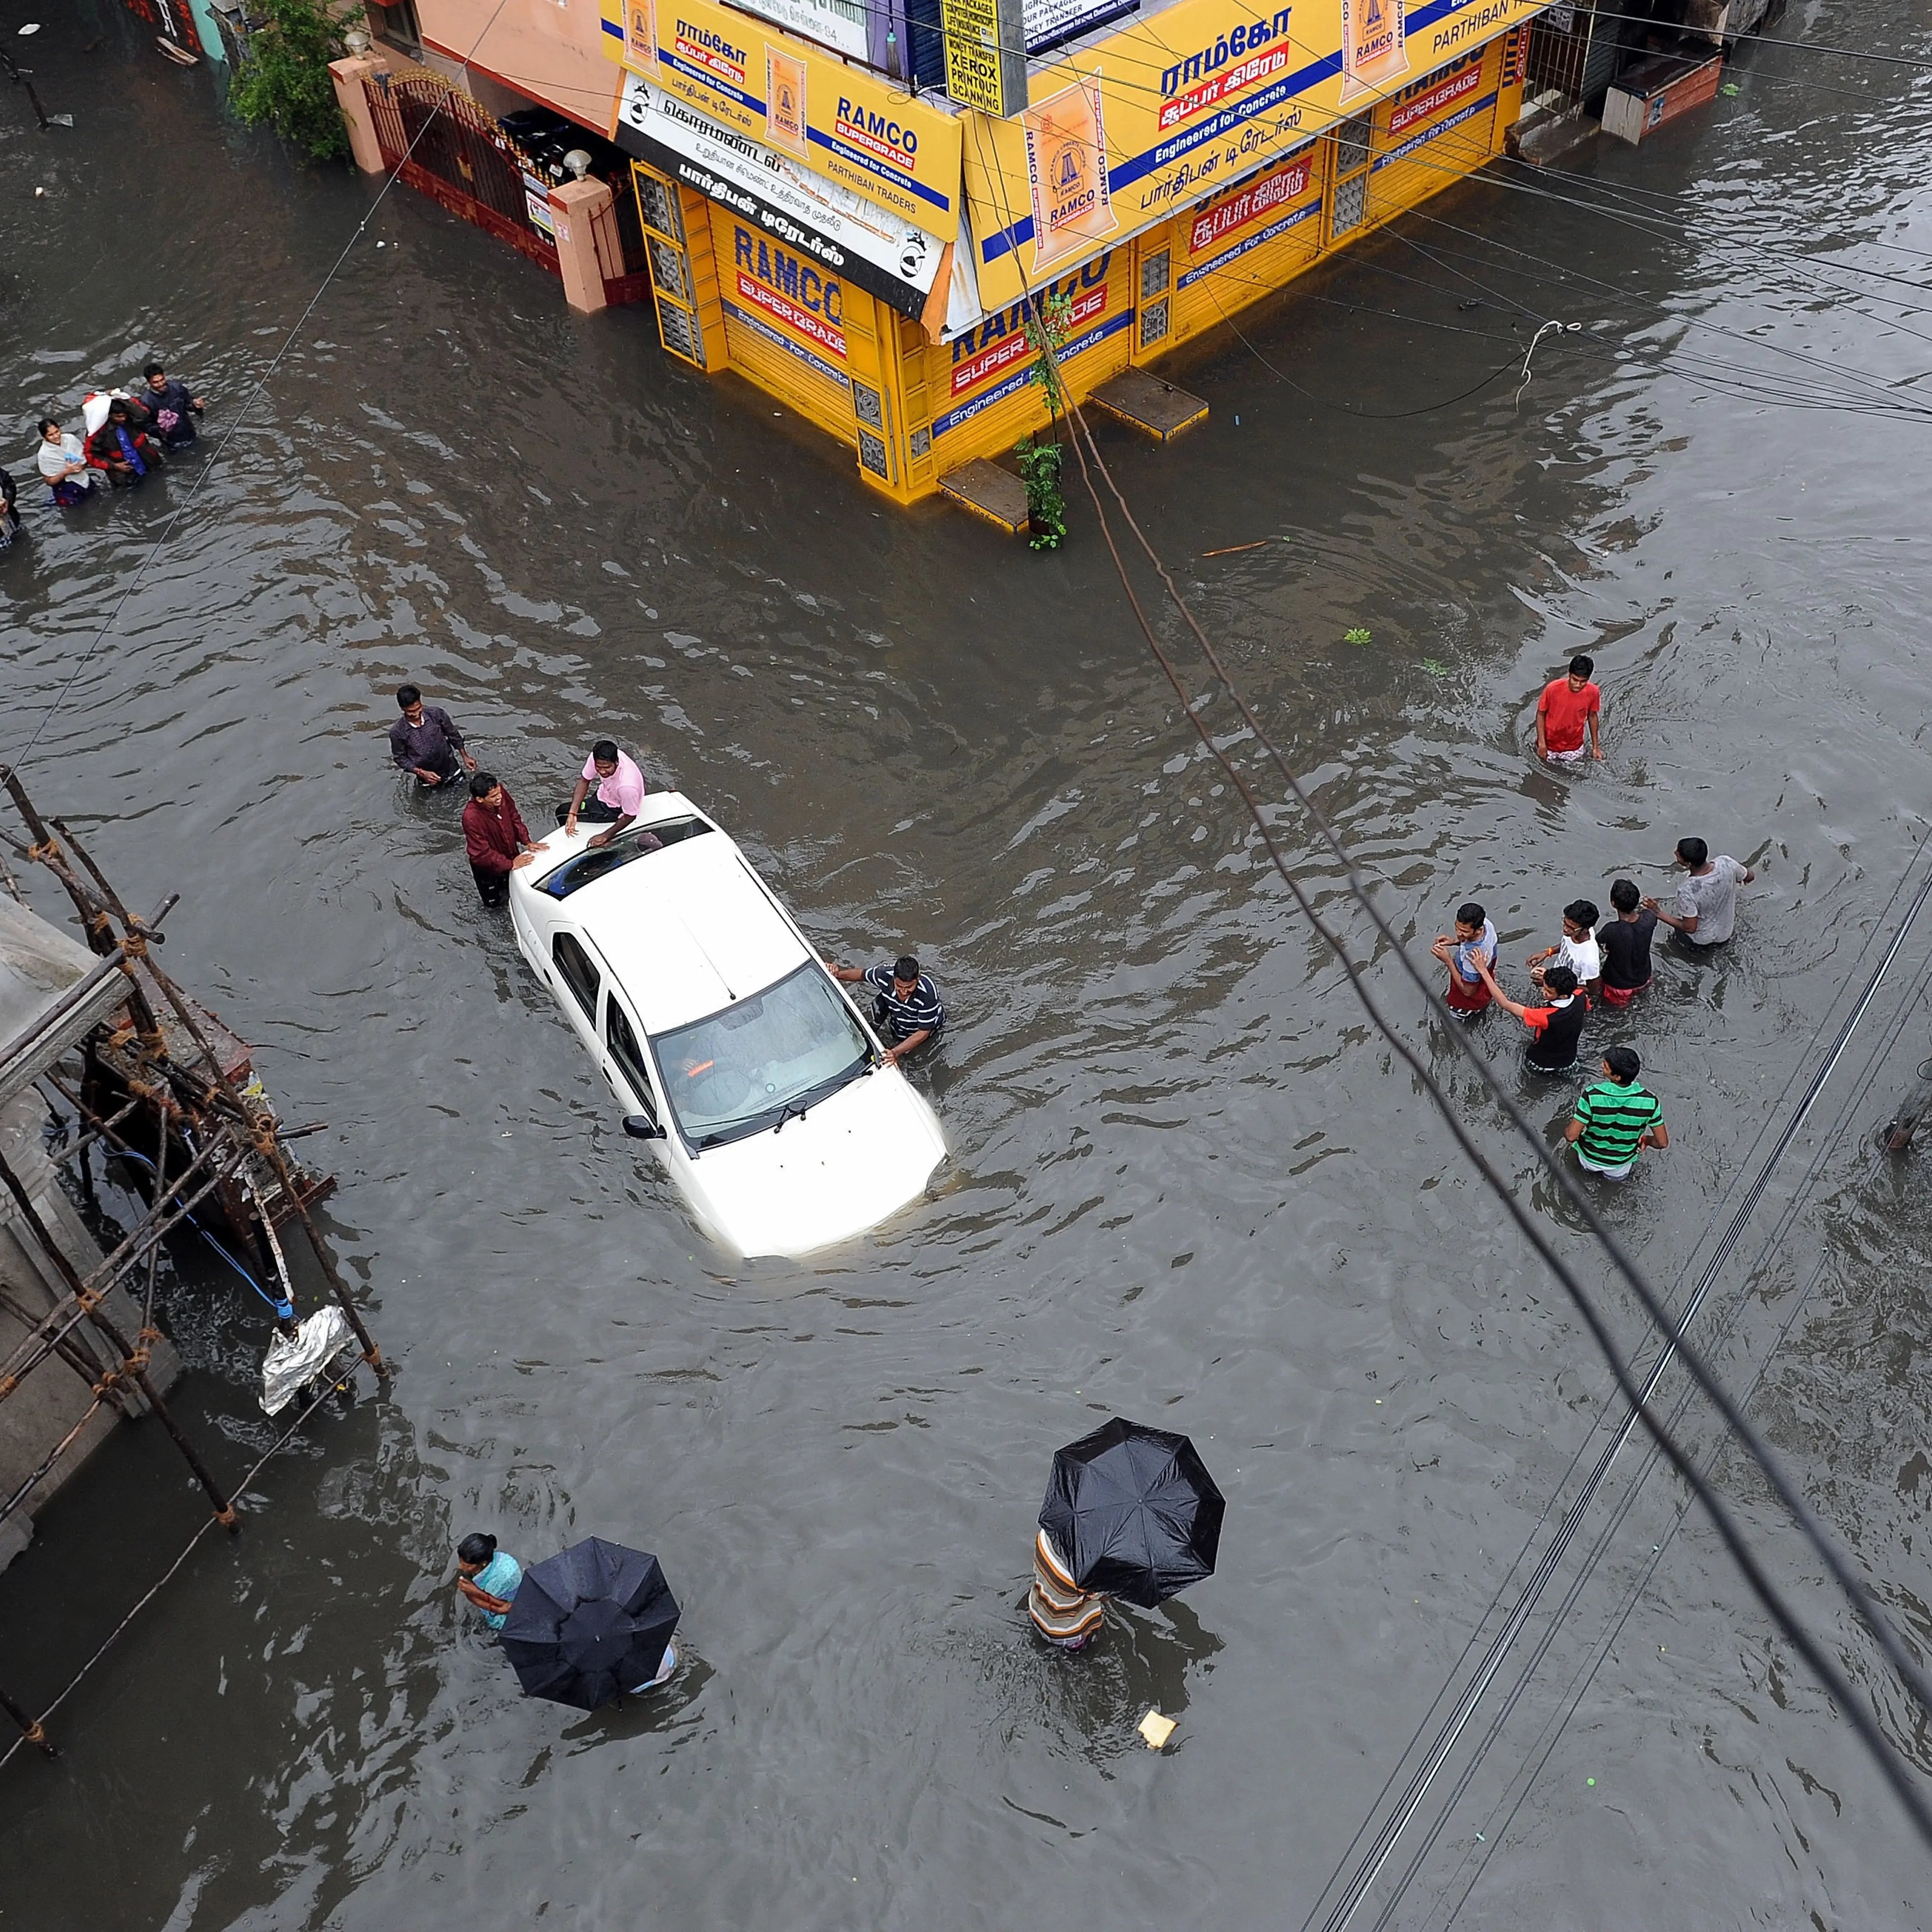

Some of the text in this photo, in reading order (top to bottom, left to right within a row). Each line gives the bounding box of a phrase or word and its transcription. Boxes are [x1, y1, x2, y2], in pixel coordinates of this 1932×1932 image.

[1023, 13, 1037, 25] OUR
[1039, 0, 1077, 18] PACKAGE
[1023, 22, 1043, 37] ONEY
[1433, 0, 1508, 54] PARTHIBAN
[676, 19, 747, 65] ராம்கோ
[1160, 6, 1293, 101] ராம்கோ
[1357, 31, 1393, 58] RAMCO
[950, 51, 997, 82] XEROX
[951, 68, 998, 96] PRNTOUT
[952, 83, 999, 111] SCANNNG
[837, 97, 918, 153] RAMCO
[837, 122, 914, 168] SUPERGRADE
[1155, 85, 1286, 164] Engineered for Concrete
[831, 141, 912, 188] Engineered for Concrete
[1026, 131, 1037, 184] RAMCO
[1098, 155, 1109, 206] RAMCO
[1140, 150, 1221, 210] பார்திபன்
[828, 160, 917, 214] PARTHIBAN TRADERS
[1051, 189, 1095, 222] RAMCO
[1185, 211, 1306, 283] Engineered For Concrete
[734, 224, 842, 327] RAMCO
[1057, 331, 1103, 362] oncrete
[949, 376, 1023, 426] Engineered
